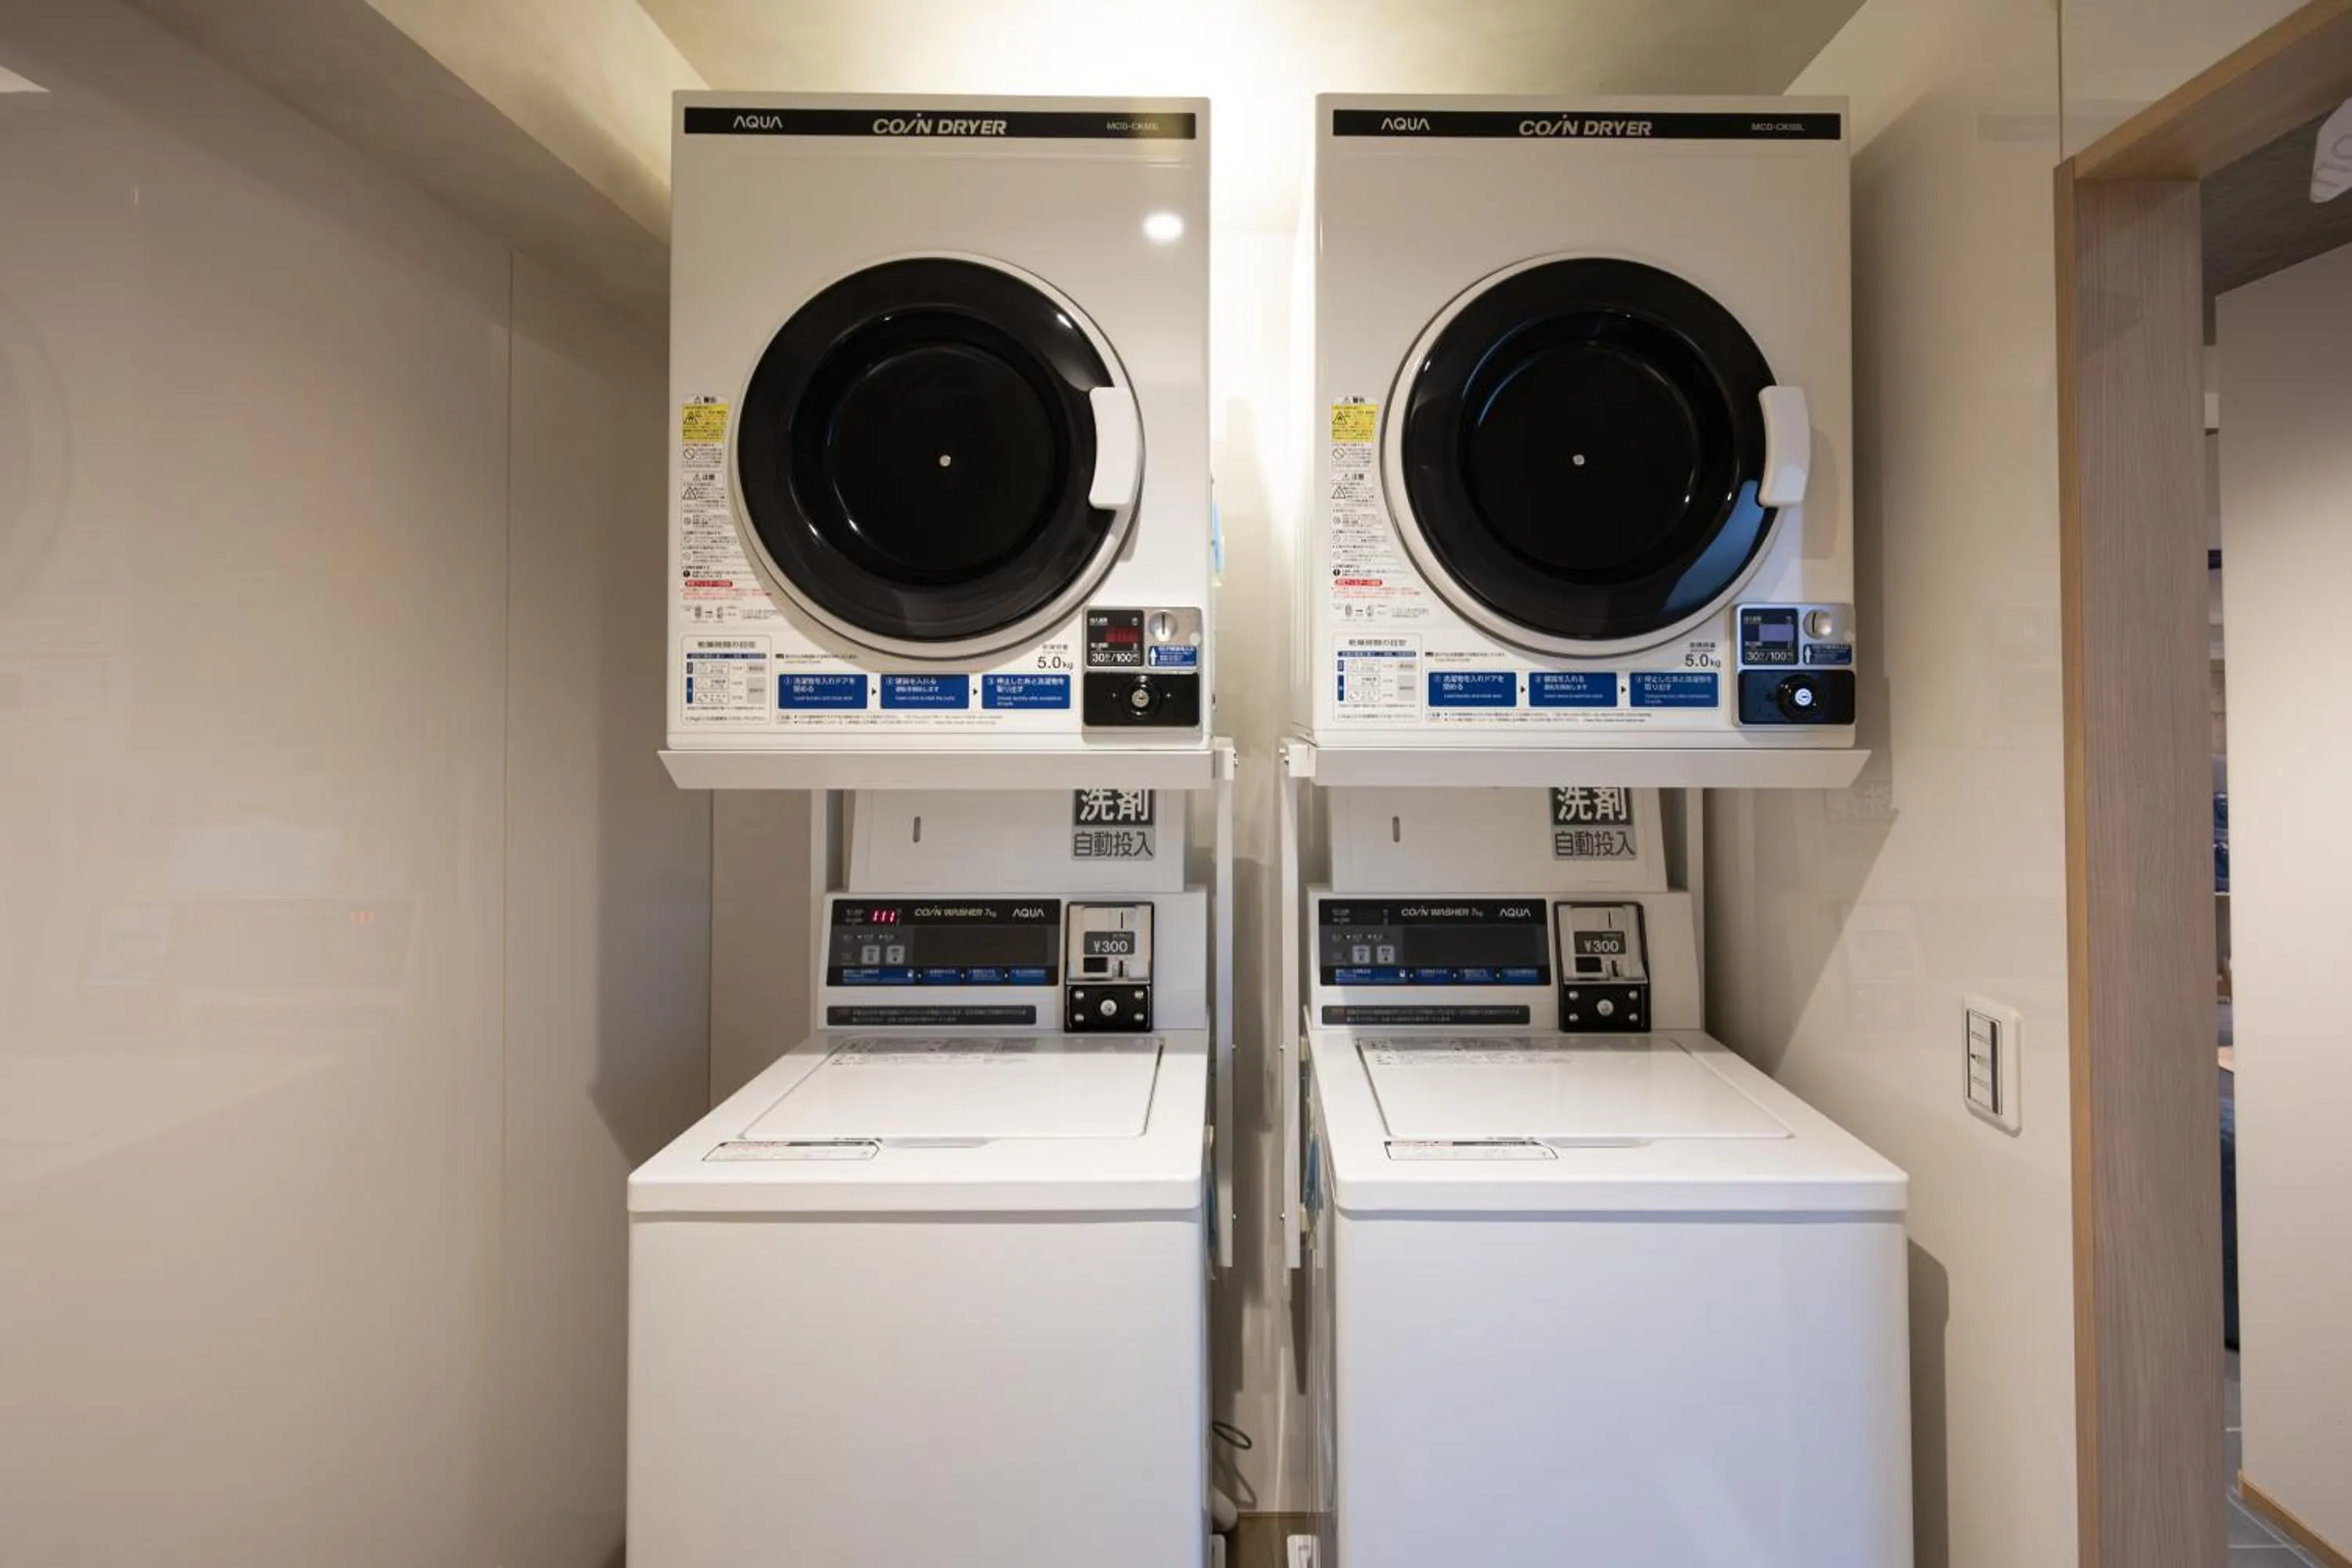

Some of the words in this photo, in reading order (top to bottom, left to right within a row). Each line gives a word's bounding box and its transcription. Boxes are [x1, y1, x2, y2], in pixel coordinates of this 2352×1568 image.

[733, 114, 783, 129] AQUA
[937, 119, 1007, 135] DRYER
[1381, 117, 1431, 131] AQUA
[1583, 120, 1653, 136] DRYER
[1080, 789, 1149, 821] 洗剤
[1557, 786, 1628, 821] 洗剤
[1074, 831, 1153, 856] 自動投入
[1555, 830, 1636, 856] 自動投入
[943, 908, 983, 916] WASHER
[1012, 907, 1046, 917] AQUA
[1430, 907, 1470, 916] WASHER
[1499, 907, 1531, 917] AQUA
[1094, 940, 1128, 953] ¥300
